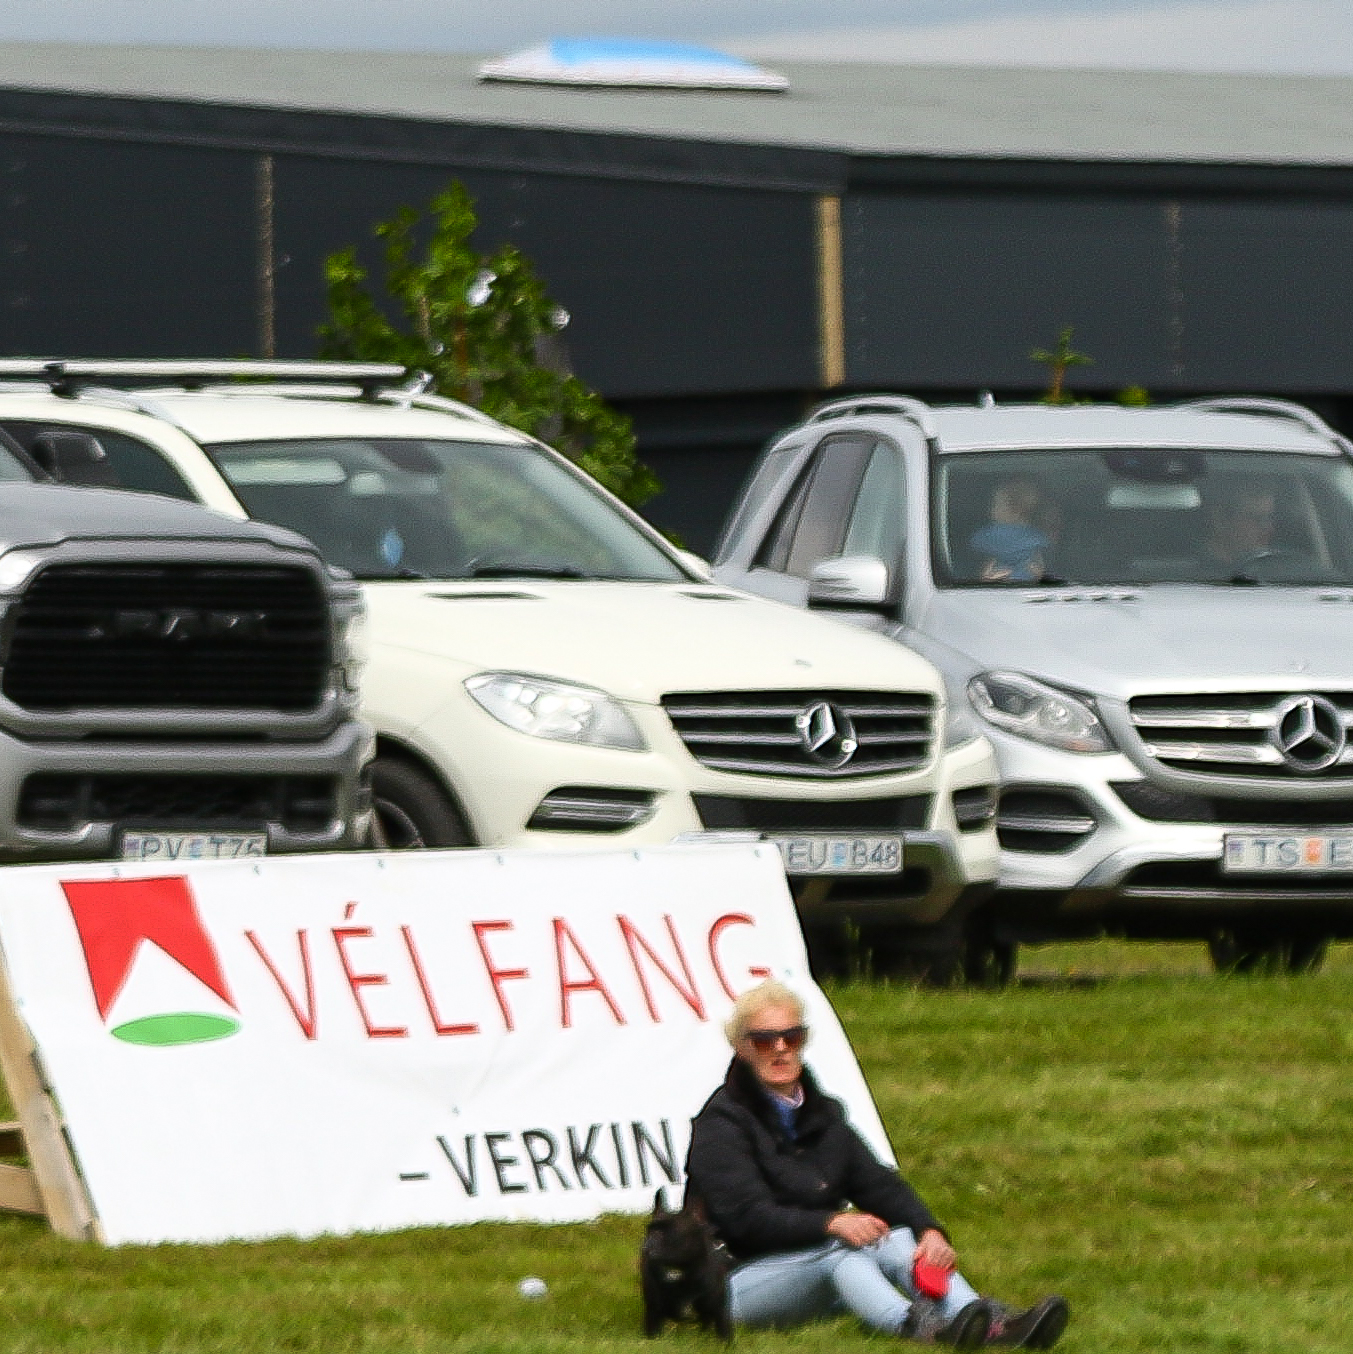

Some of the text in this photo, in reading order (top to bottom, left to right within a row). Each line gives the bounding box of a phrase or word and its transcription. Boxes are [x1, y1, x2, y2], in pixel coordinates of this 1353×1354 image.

[141, 837, 184, 861] PV
[787, 840, 900, 868] EU B48
[1253, 839, 1300, 867] TS
[244, 902, 773, 1041] VÉLFANG
